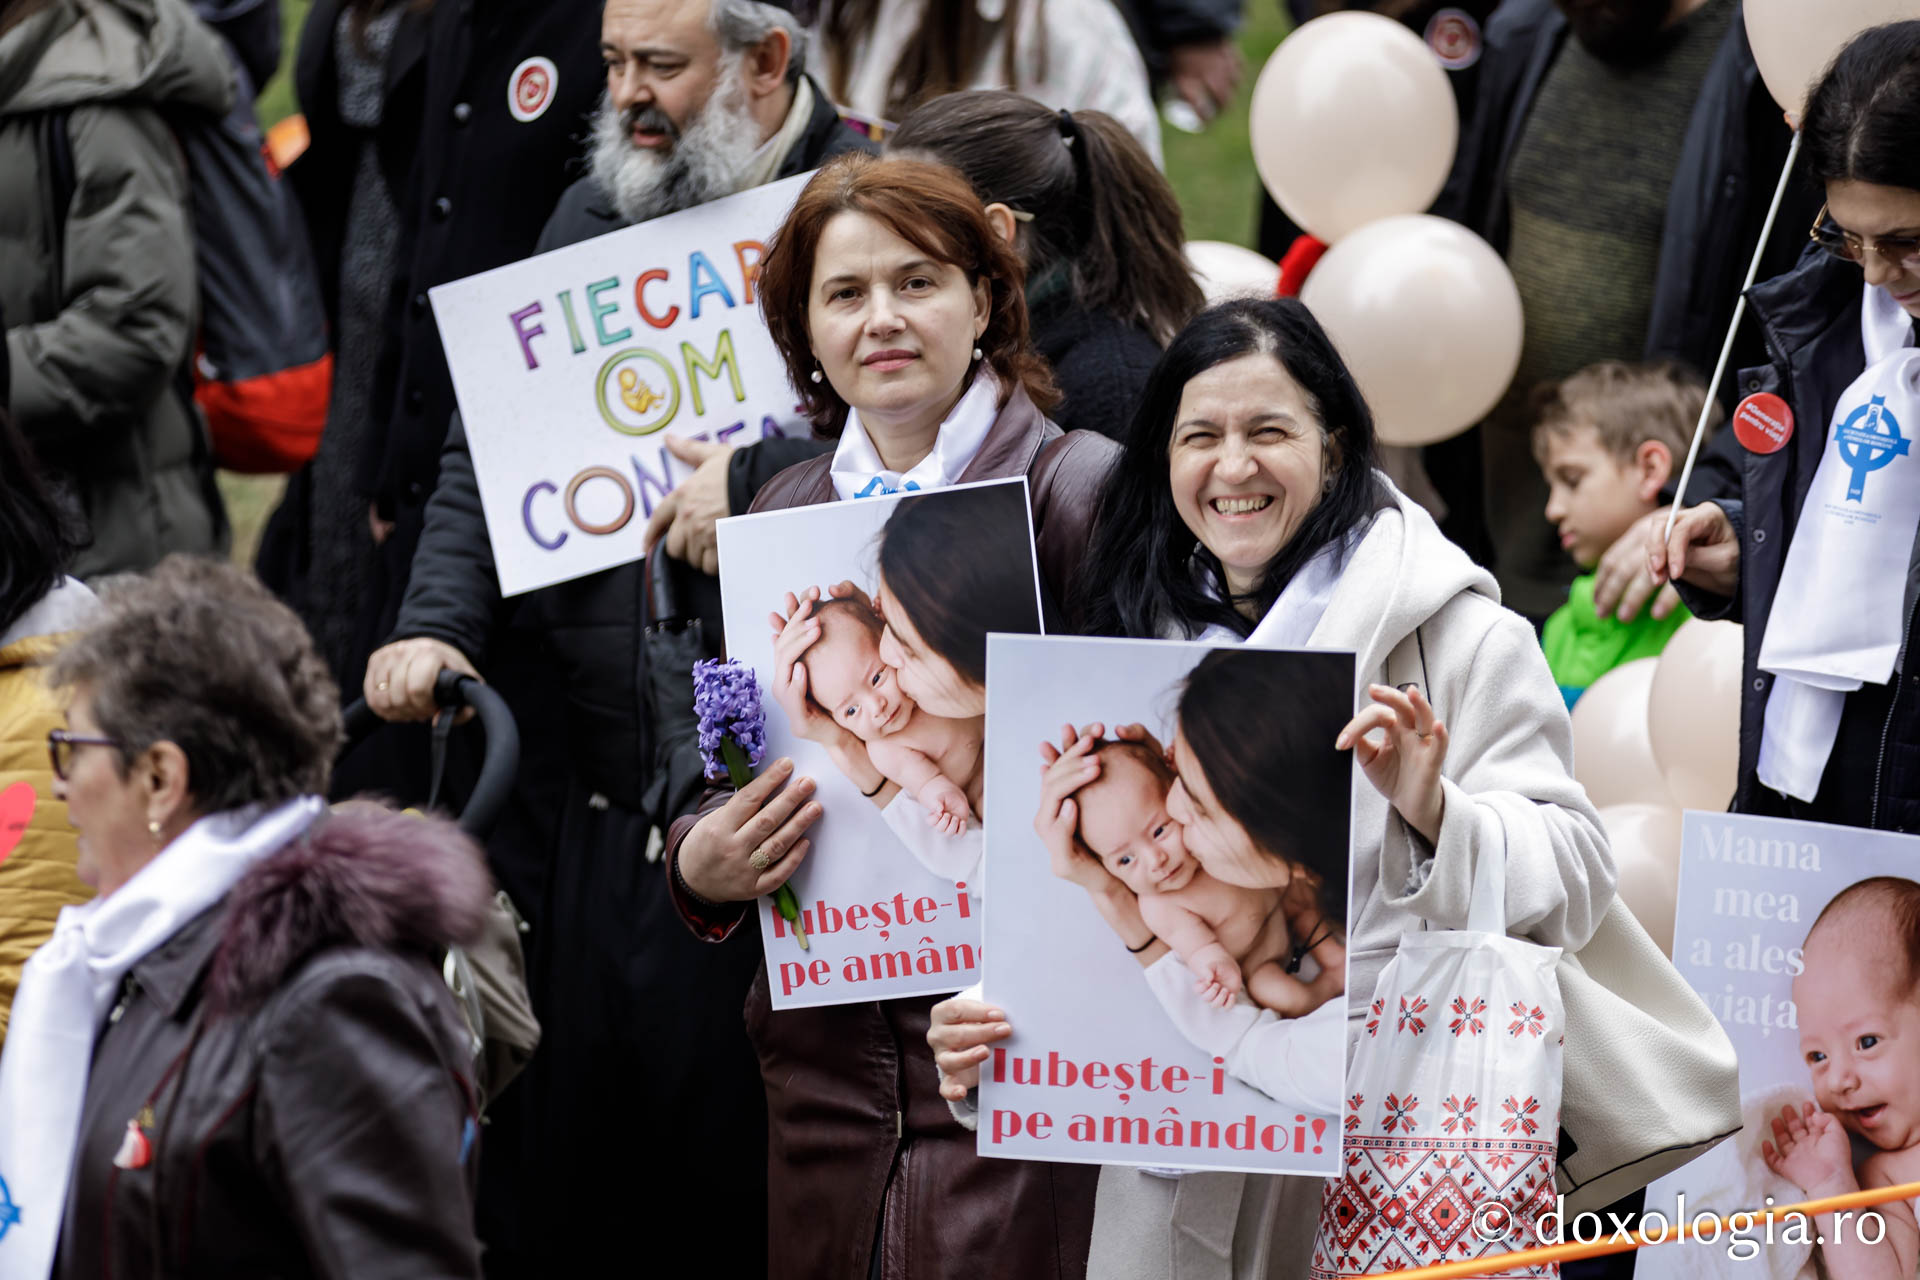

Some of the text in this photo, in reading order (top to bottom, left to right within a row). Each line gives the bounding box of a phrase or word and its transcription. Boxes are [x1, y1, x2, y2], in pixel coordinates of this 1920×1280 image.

[509, 240, 766, 370] FIECAR
[596, 329, 745, 436] OM
[1698, 824, 1822, 872] Mama
[1712, 887, 1800, 923] mea
[780, 936, 982, 996] pe amân
[1689, 933, 1805, 977] a ales
[993, 1048, 1225, 1105] Iubește-i
[992, 1106, 1327, 1155] pe amândoi!
